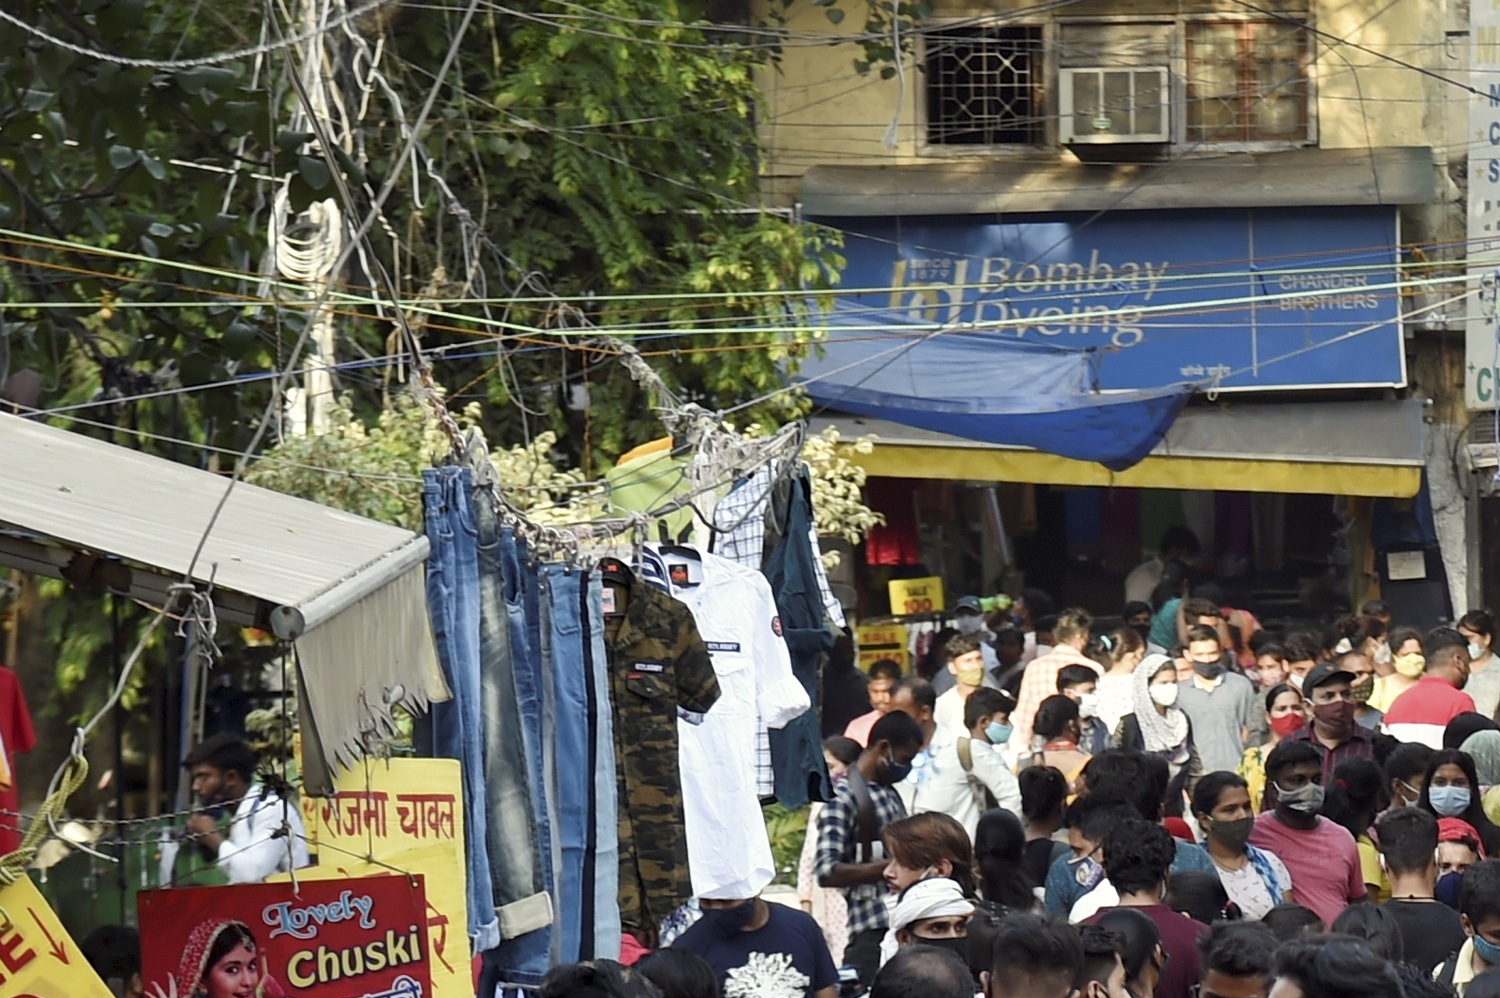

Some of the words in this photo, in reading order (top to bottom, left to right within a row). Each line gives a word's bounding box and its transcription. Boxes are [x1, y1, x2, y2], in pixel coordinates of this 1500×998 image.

[978, 249, 1169, 301] Bombay
[1279, 274, 1368, 290] CHANDER
[974, 297, 1145, 347] Dyeing
[1279, 294, 1379, 311] BROTHERS
[396, 793, 456, 840] चावल
[262, 890, 377, 940] Lovely
[287, 925, 422, 989] Chuski
